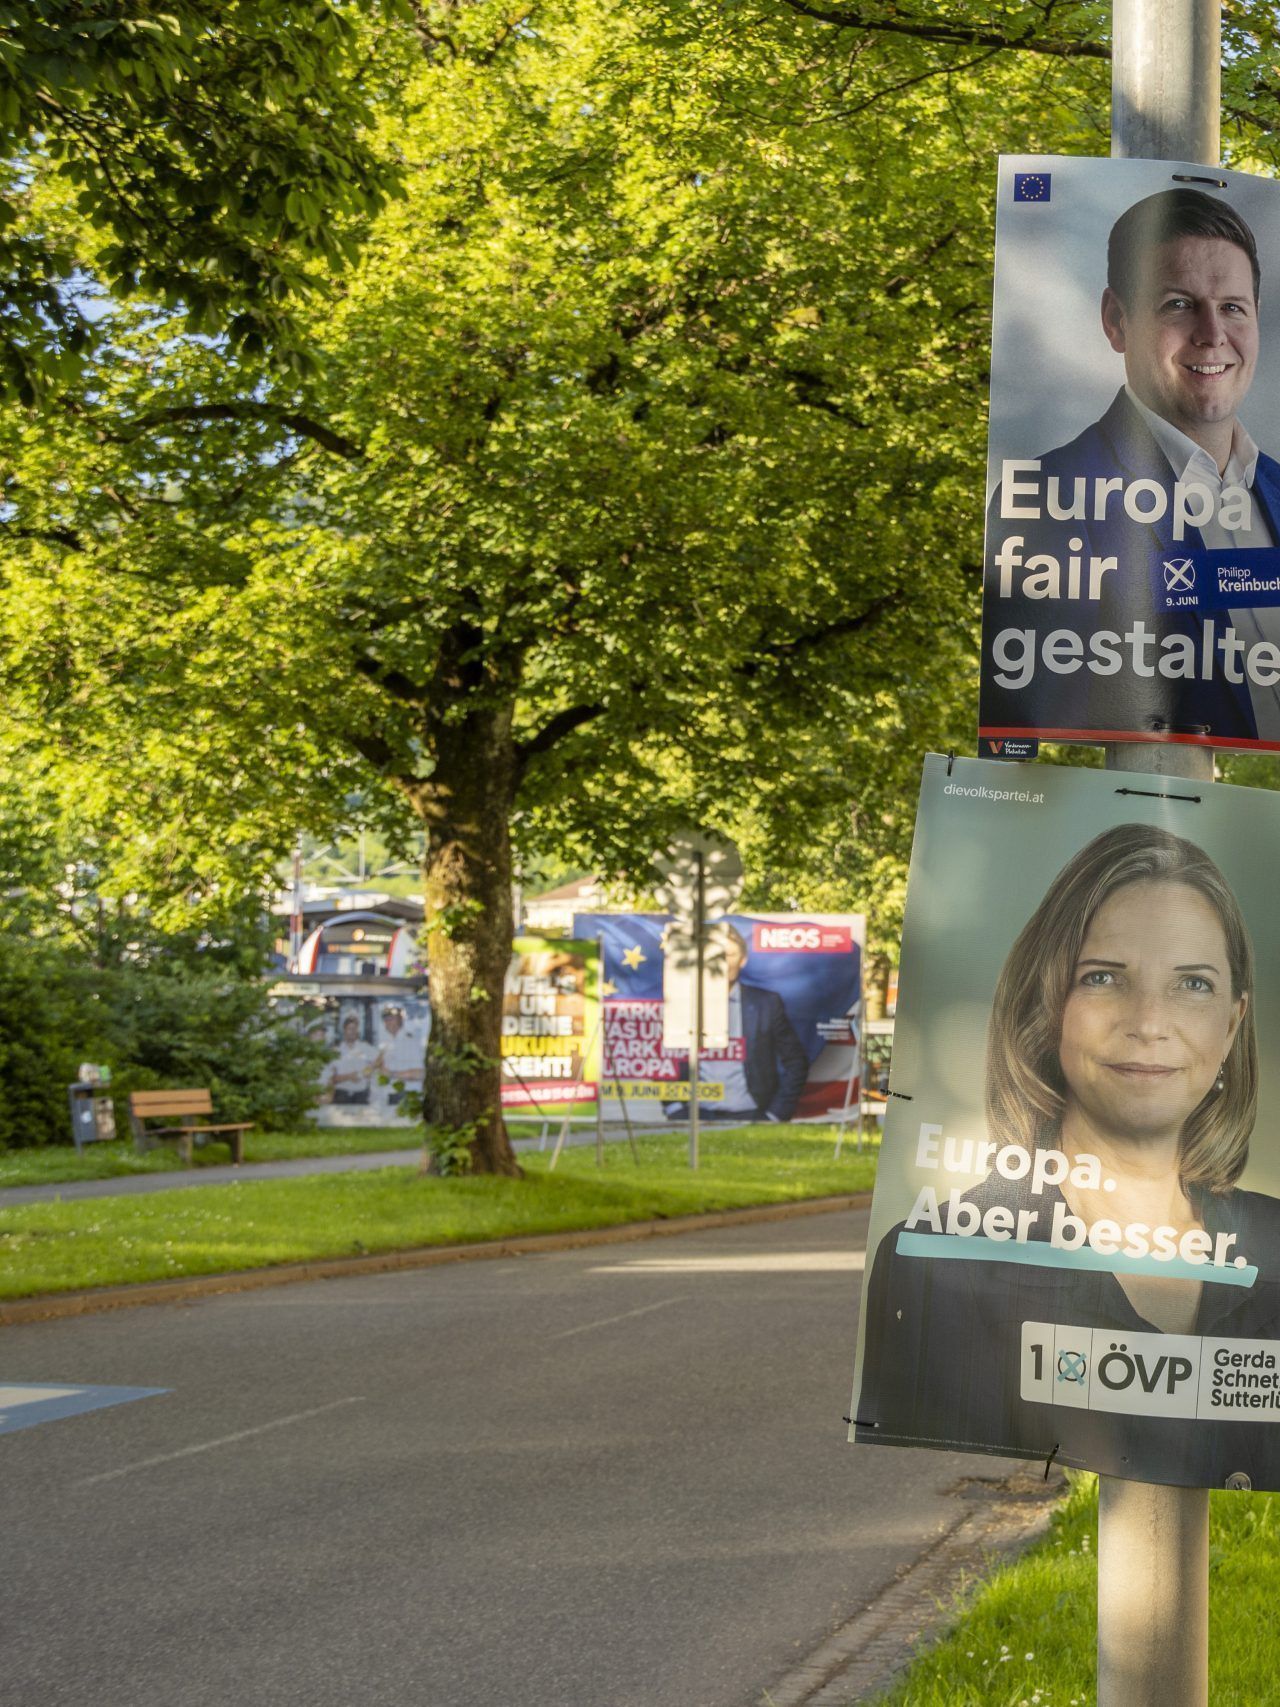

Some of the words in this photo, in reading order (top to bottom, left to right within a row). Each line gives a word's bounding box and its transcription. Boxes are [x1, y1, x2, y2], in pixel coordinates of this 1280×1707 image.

[1000, 459, 1252, 541] Europa
[994, 535, 1118, 600] fair
[1217, 567, 1251, 578] Philipp
[1166, 597, 1175, 607] 9.
[1176, 596, 1199, 606] JUNI
[943, 784, 1045, 804] dievolkspartei.at
[760, 928, 820, 948] NEOS
[502, 1015, 573, 1036] DEINE
[605, 1021, 637, 1039] AS
[500, 1036, 586, 1057] UKUNFT
[604, 1040, 656, 1058] TARK
[603, 1059, 676, 1077] UROPA
[915, 1122, 1118, 1195] Europa.
[904, 1186, 1039, 1244] Aber
[1050, 1202, 1248, 1270] besser.
[1030, 1344, 1043, 1381] 1
[1097, 1342, 1193, 1395] ÖVP
[1213, 1348, 1276, 1370] Gerda
